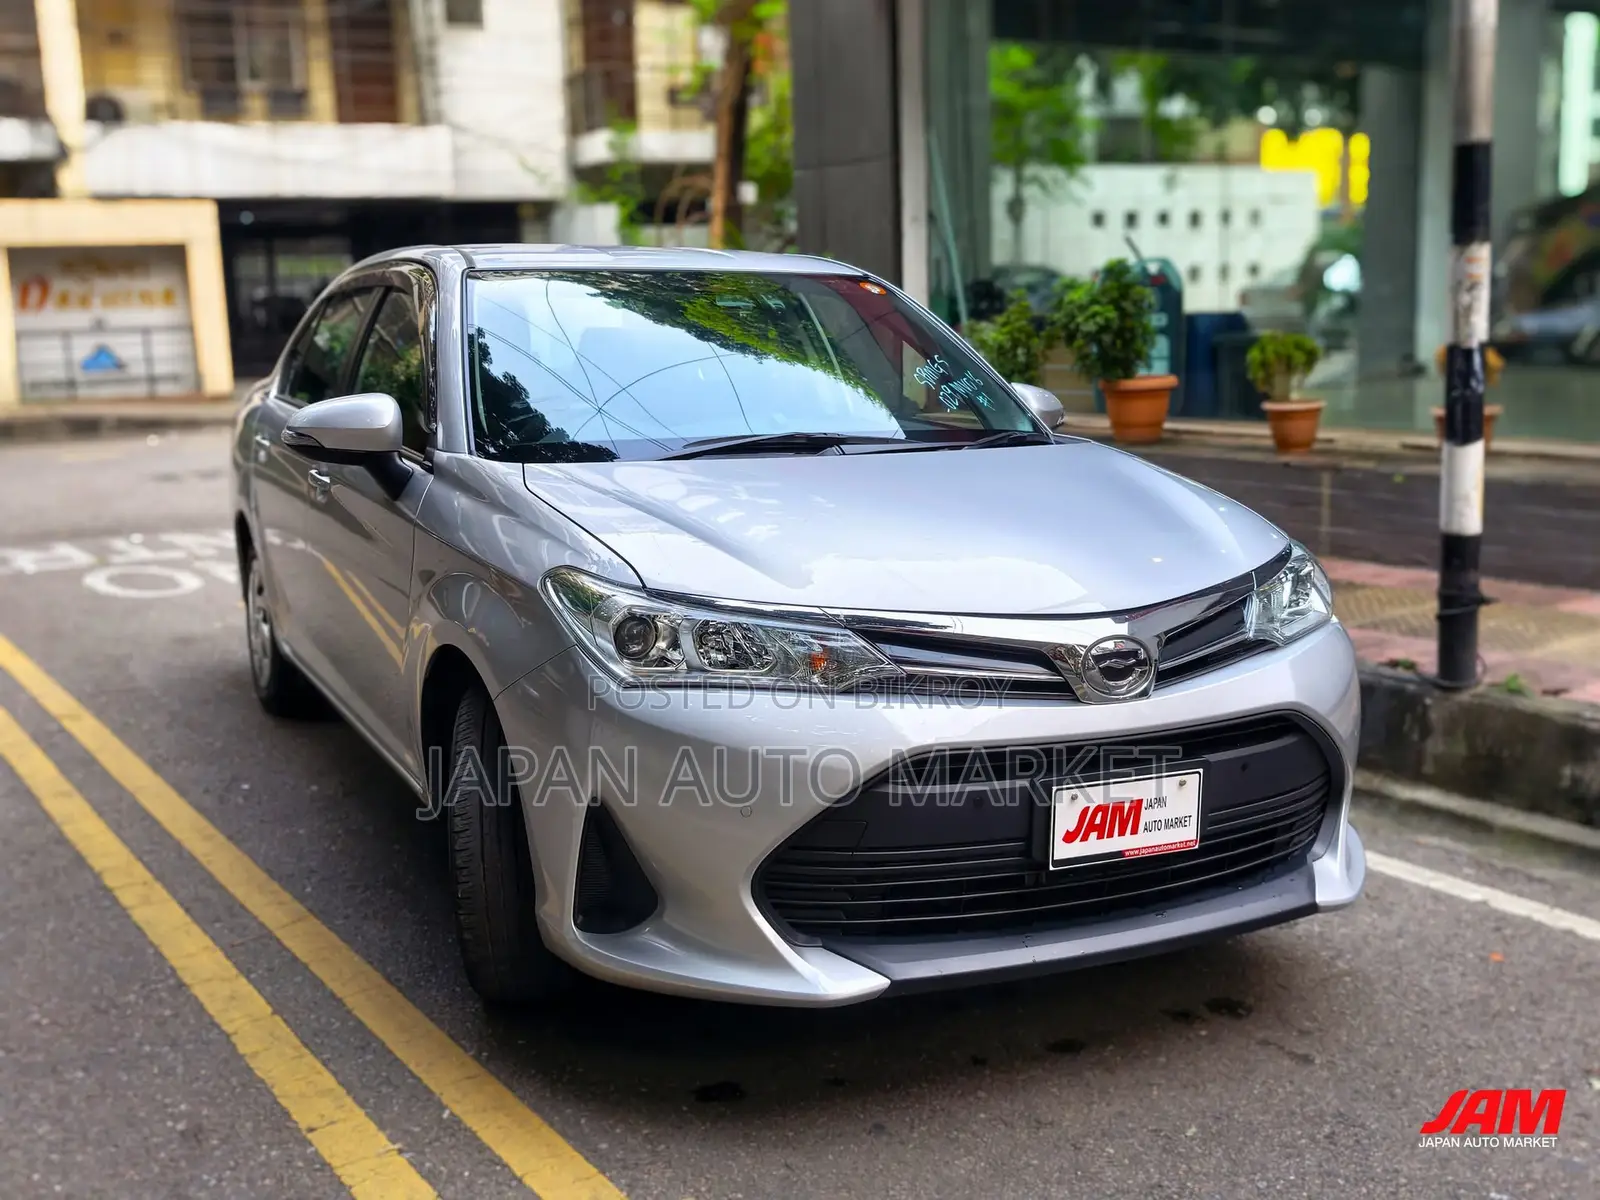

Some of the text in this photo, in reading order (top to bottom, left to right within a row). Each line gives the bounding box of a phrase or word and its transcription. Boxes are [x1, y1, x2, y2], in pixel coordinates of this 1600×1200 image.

[1144, 796, 1167, 810] JAPAN
[1062, 799, 1143, 844] JAM
[1143, 815, 1192, 833] AUTO MARKET
[1124, 840, 1196, 856] www.japanautomarket.net
